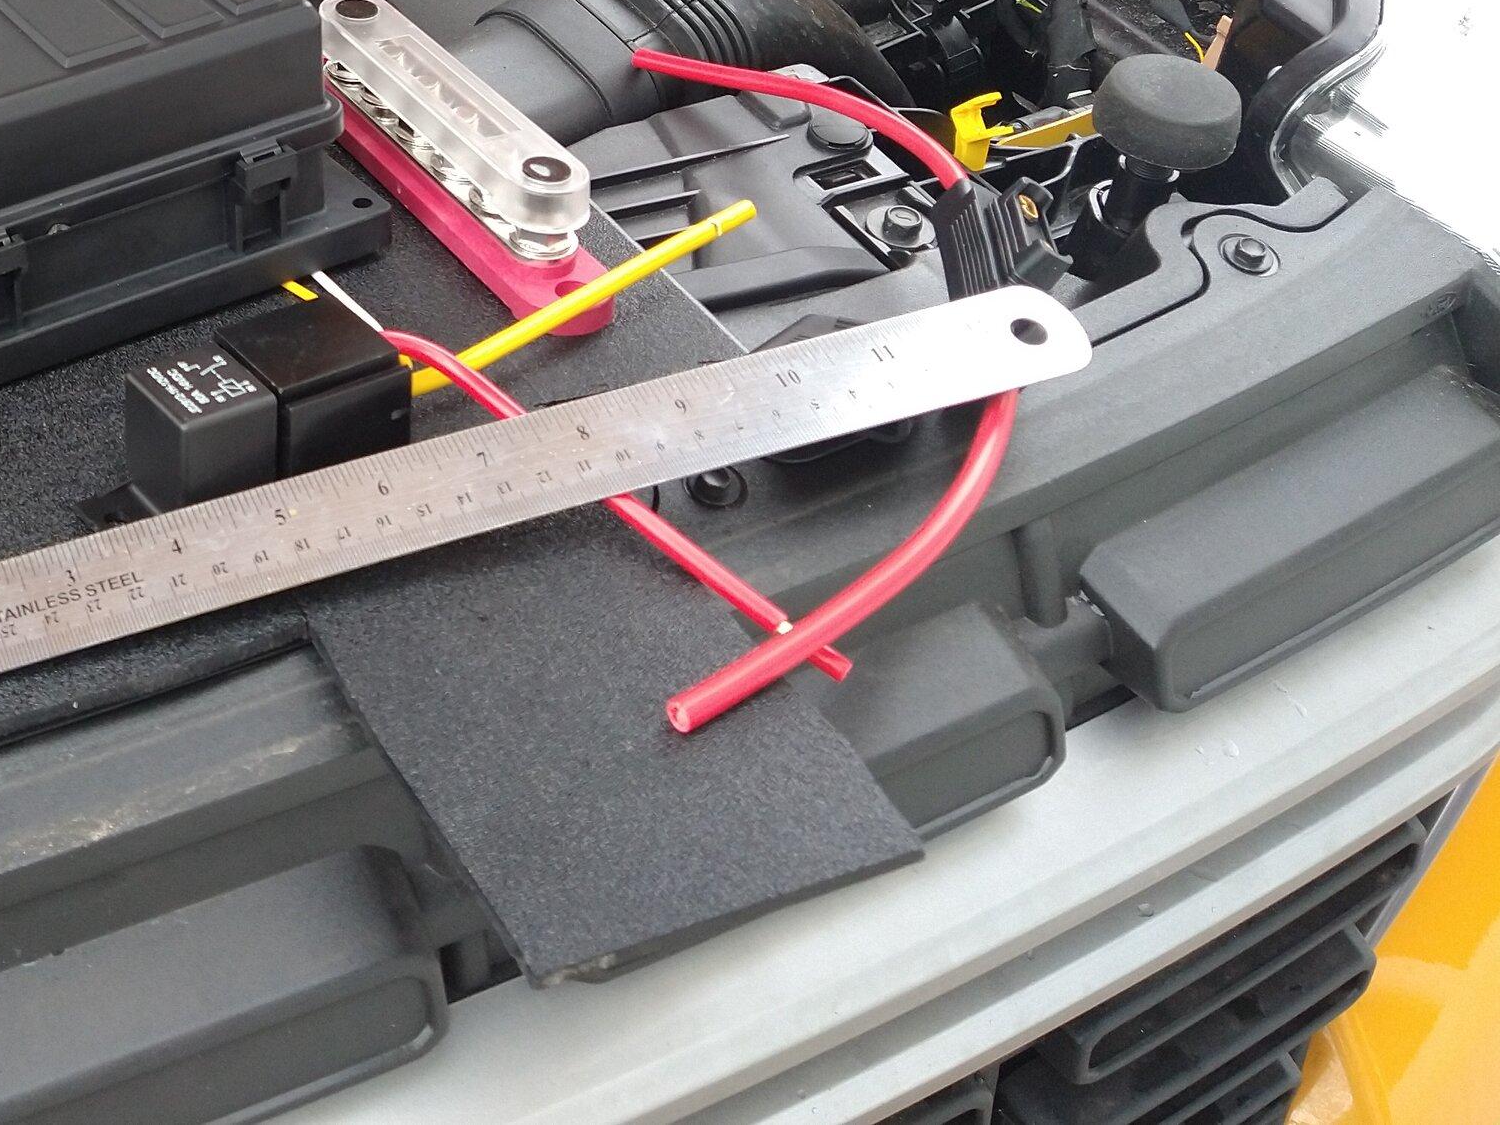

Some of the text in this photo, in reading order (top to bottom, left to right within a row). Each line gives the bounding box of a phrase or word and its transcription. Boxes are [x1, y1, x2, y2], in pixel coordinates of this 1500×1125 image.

[615, 449, 632, 463] 10
[65, 569, 77, 587] 3
[171, 539, 183, 555] 4
[274, 509, 287, 526] 5
[377, 480, 390, 496] 6
[476, 451, 489, 468] 7
[576, 425, 591, 441] 8
[674, 398, 688, 415] 9
[774, 368, 802, 388] 10
[870, 345, 895, 363] 11
[577, 458, 593, 473] 11
[536, 470, 553, 484] 12
[496, 481, 513, 495] 13
[456, 491, 473, 506] 14
[415, 502, 433, 518] 15
[376, 514, 393, 528] 16
[336, 526, 352, 541] 17
[294, 538, 311, 552] 18
[254, 550, 270, 564] 19
[211, 561, 229, 576] 20
[84, 571, 145, 598] STEEL
[171, 574, 188, 588] 21
[129, 586, 146, 601] 22
[86, 599, 103, 614] 23
[43, 611, 60, 626] 24
[0, 623, 18, 639] 25
